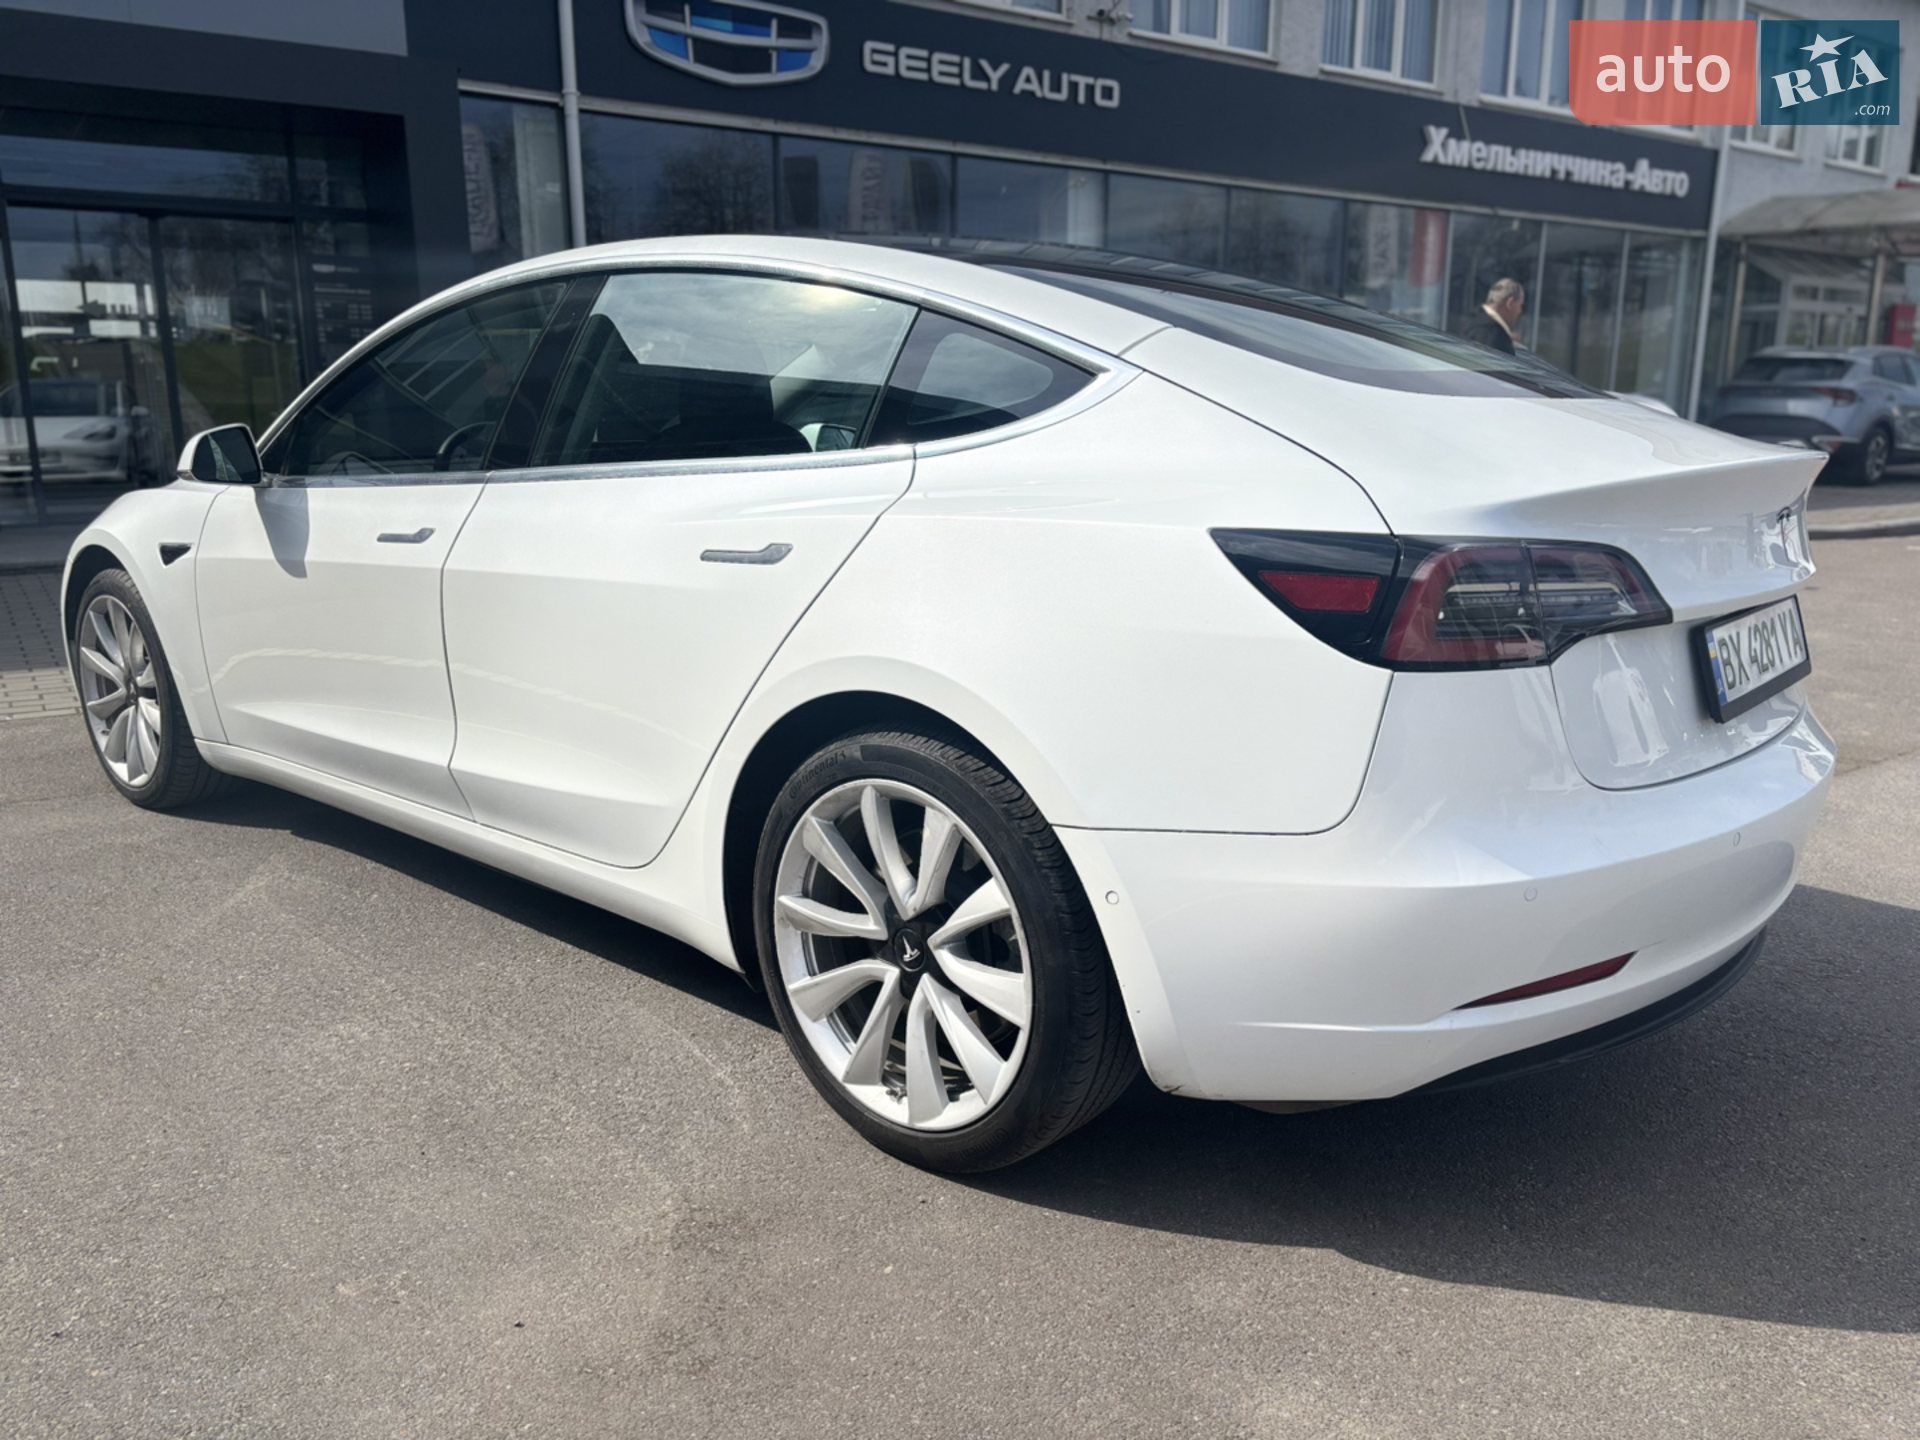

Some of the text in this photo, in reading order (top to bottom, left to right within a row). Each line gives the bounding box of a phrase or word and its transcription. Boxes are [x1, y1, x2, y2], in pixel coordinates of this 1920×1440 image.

[862, 40, 1121, 109] GEELY AUTO
[1419, 125, 1689, 197] Хмельниччина-Авто
[1718, 608, 1803, 690] BX 4281 YA
[788, 751, 840, 801] Continental
